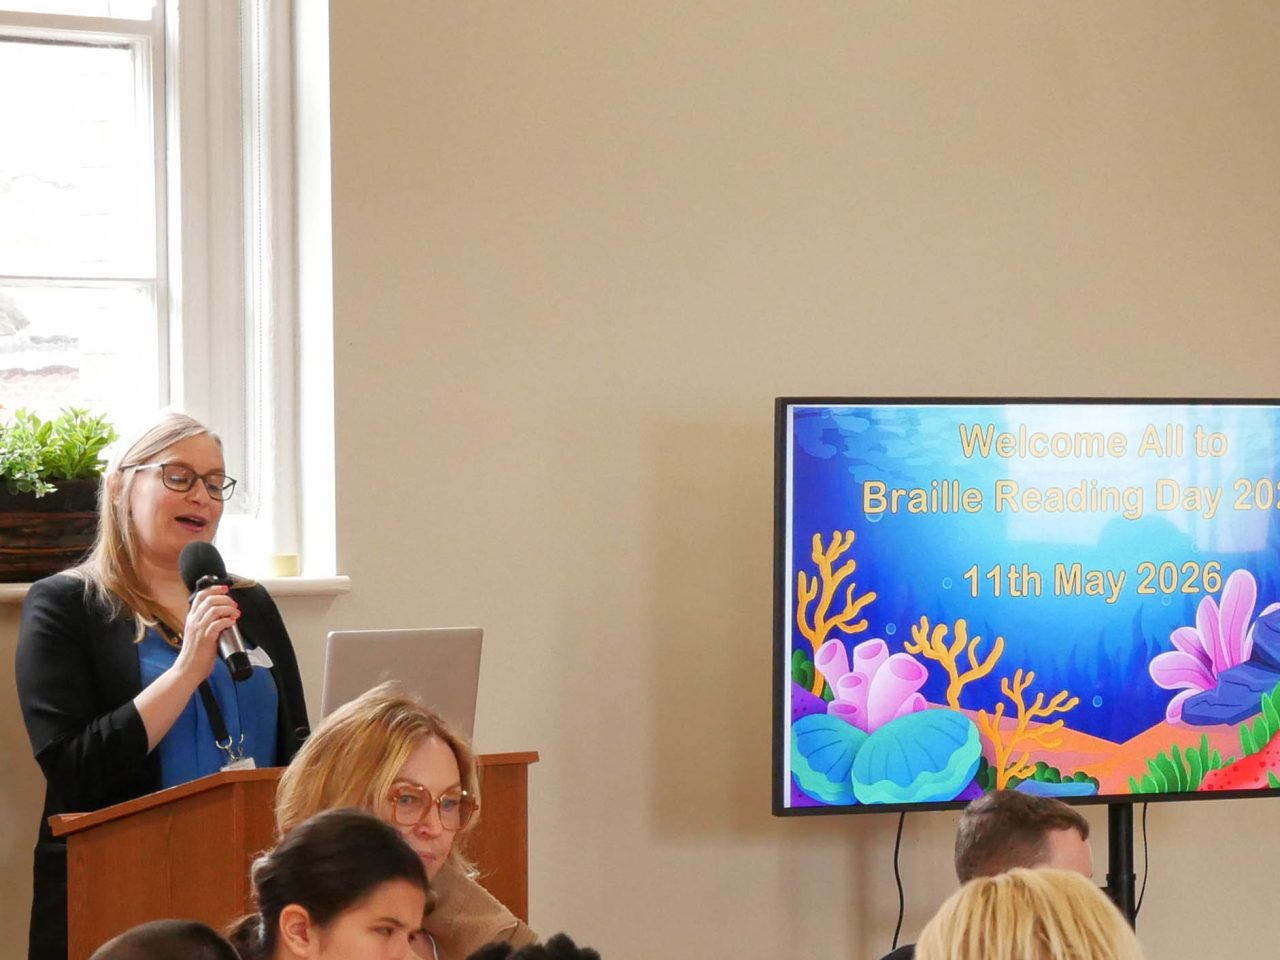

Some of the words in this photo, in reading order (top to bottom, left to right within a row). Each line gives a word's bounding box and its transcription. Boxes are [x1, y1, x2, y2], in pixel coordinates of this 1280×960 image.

[959, 423, 1128, 458] Welcome
[1138, 423, 1183, 458] All
[1194, 425, 1228, 458] to
[862, 480, 984, 514] Braille
[995, 479, 1144, 520] Reading
[1156, 478, 1223, 519] Day
[964, 563, 1043, 598] 11th
[1054, 562, 1126, 604] May
[1136, 560, 1222, 595] 2026
